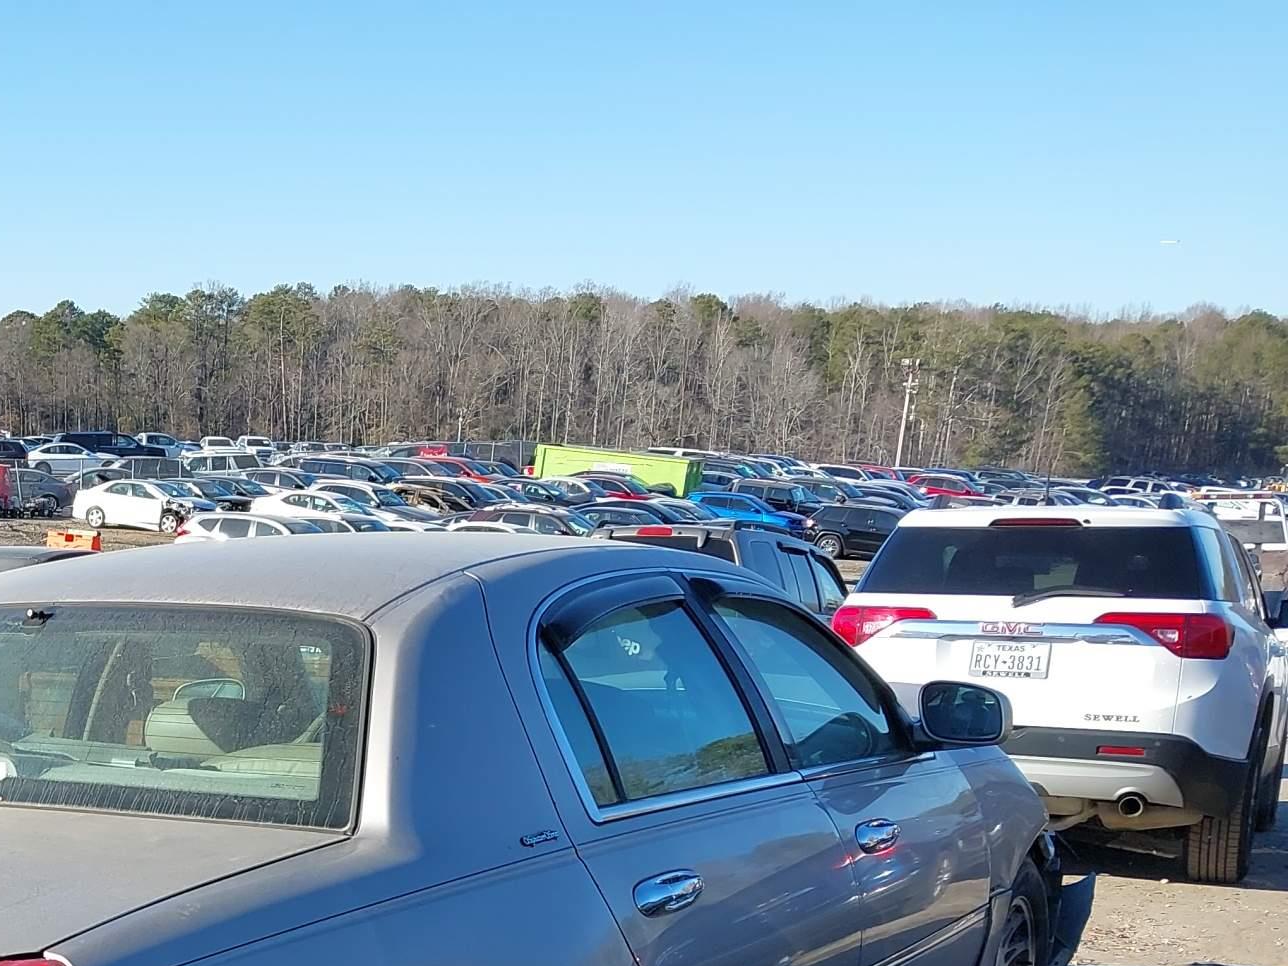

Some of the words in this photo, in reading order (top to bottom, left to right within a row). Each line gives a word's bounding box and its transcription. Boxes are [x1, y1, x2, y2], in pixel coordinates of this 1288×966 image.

[980, 622, 1044, 638] GMC
[997, 645, 1025, 653] TEXAS
[974, 653, 1042, 671] RCY-3831
[1083, 713, 1141, 723] SEWELL
